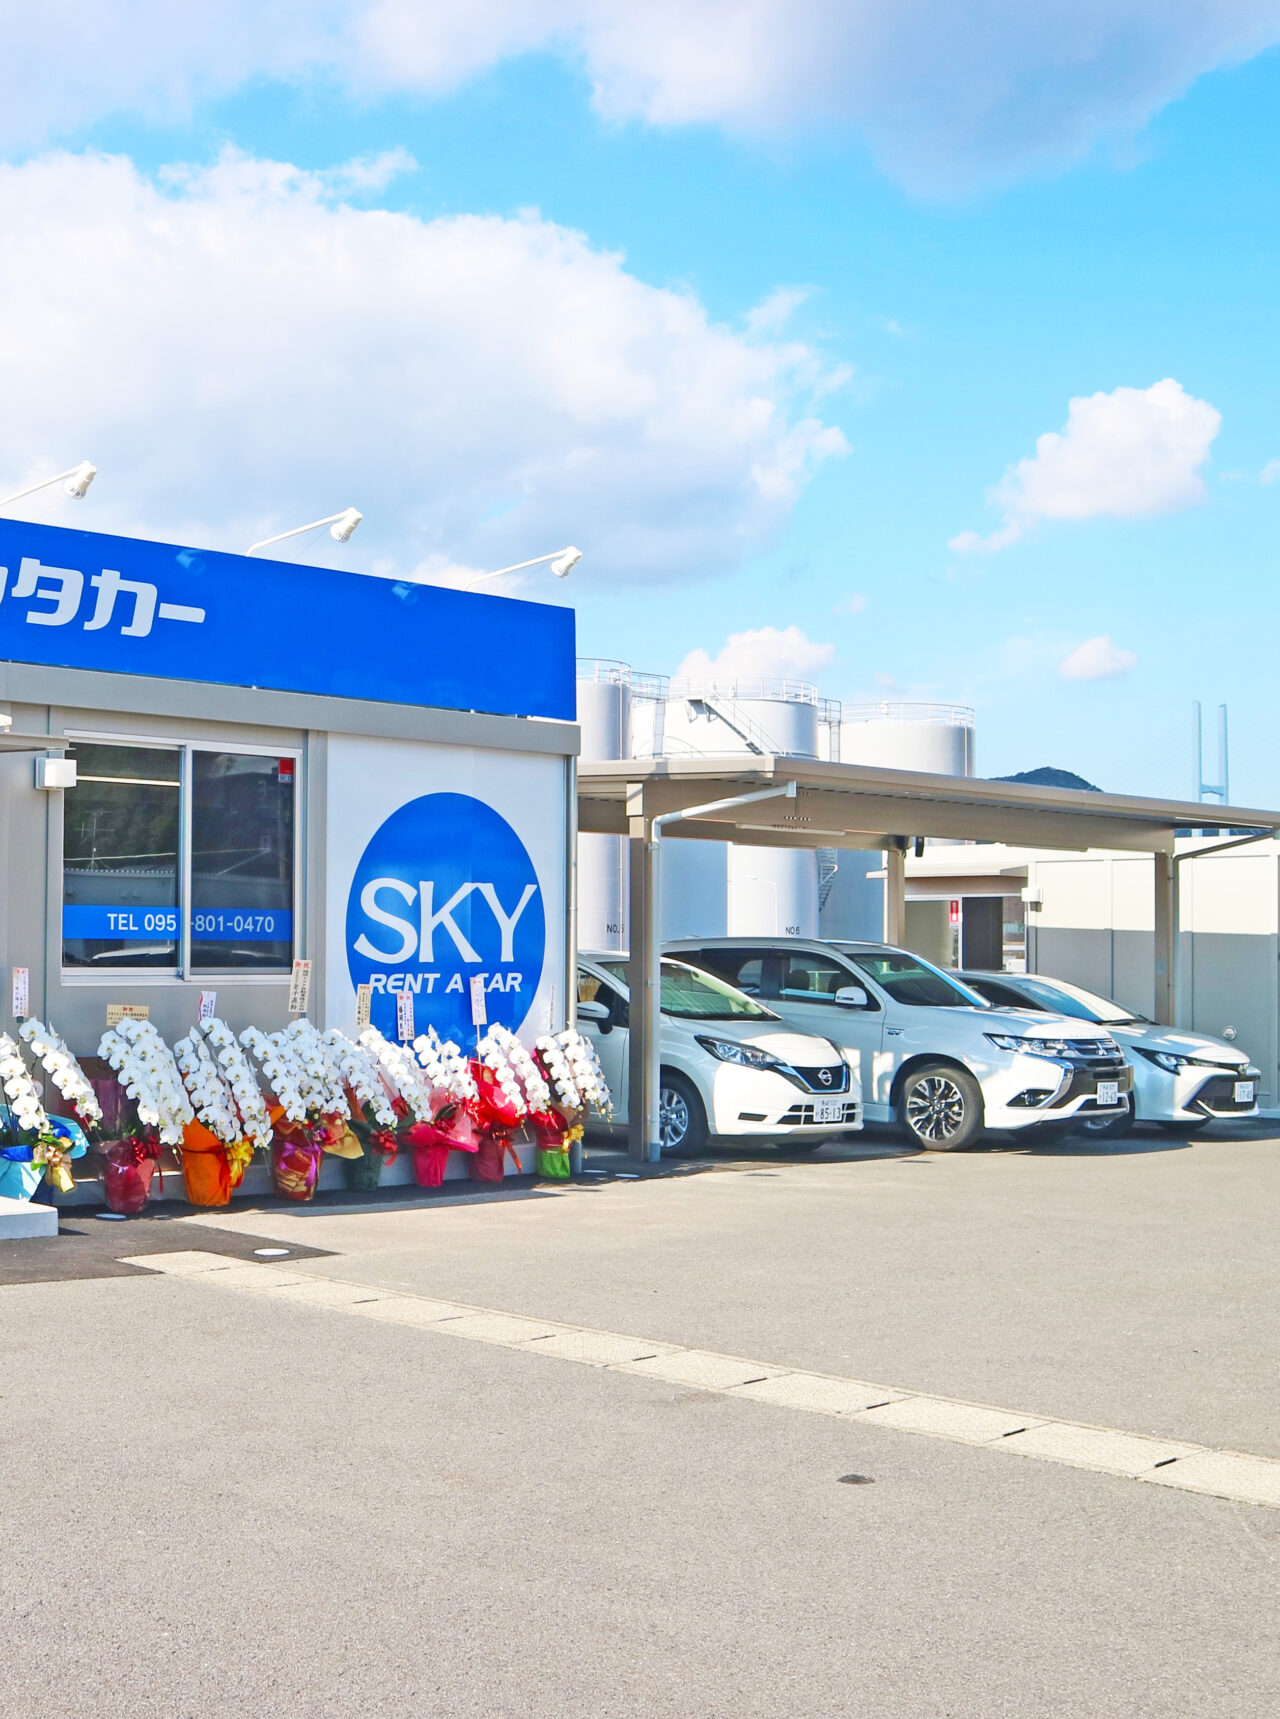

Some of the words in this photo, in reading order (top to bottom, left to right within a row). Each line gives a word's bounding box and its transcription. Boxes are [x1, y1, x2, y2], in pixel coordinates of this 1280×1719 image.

[107, 913, 139, 931] TEL
[353, 877, 538, 964] SKY
[368, 973, 441, 995] RENT
[444, 973, 465, 993] A
